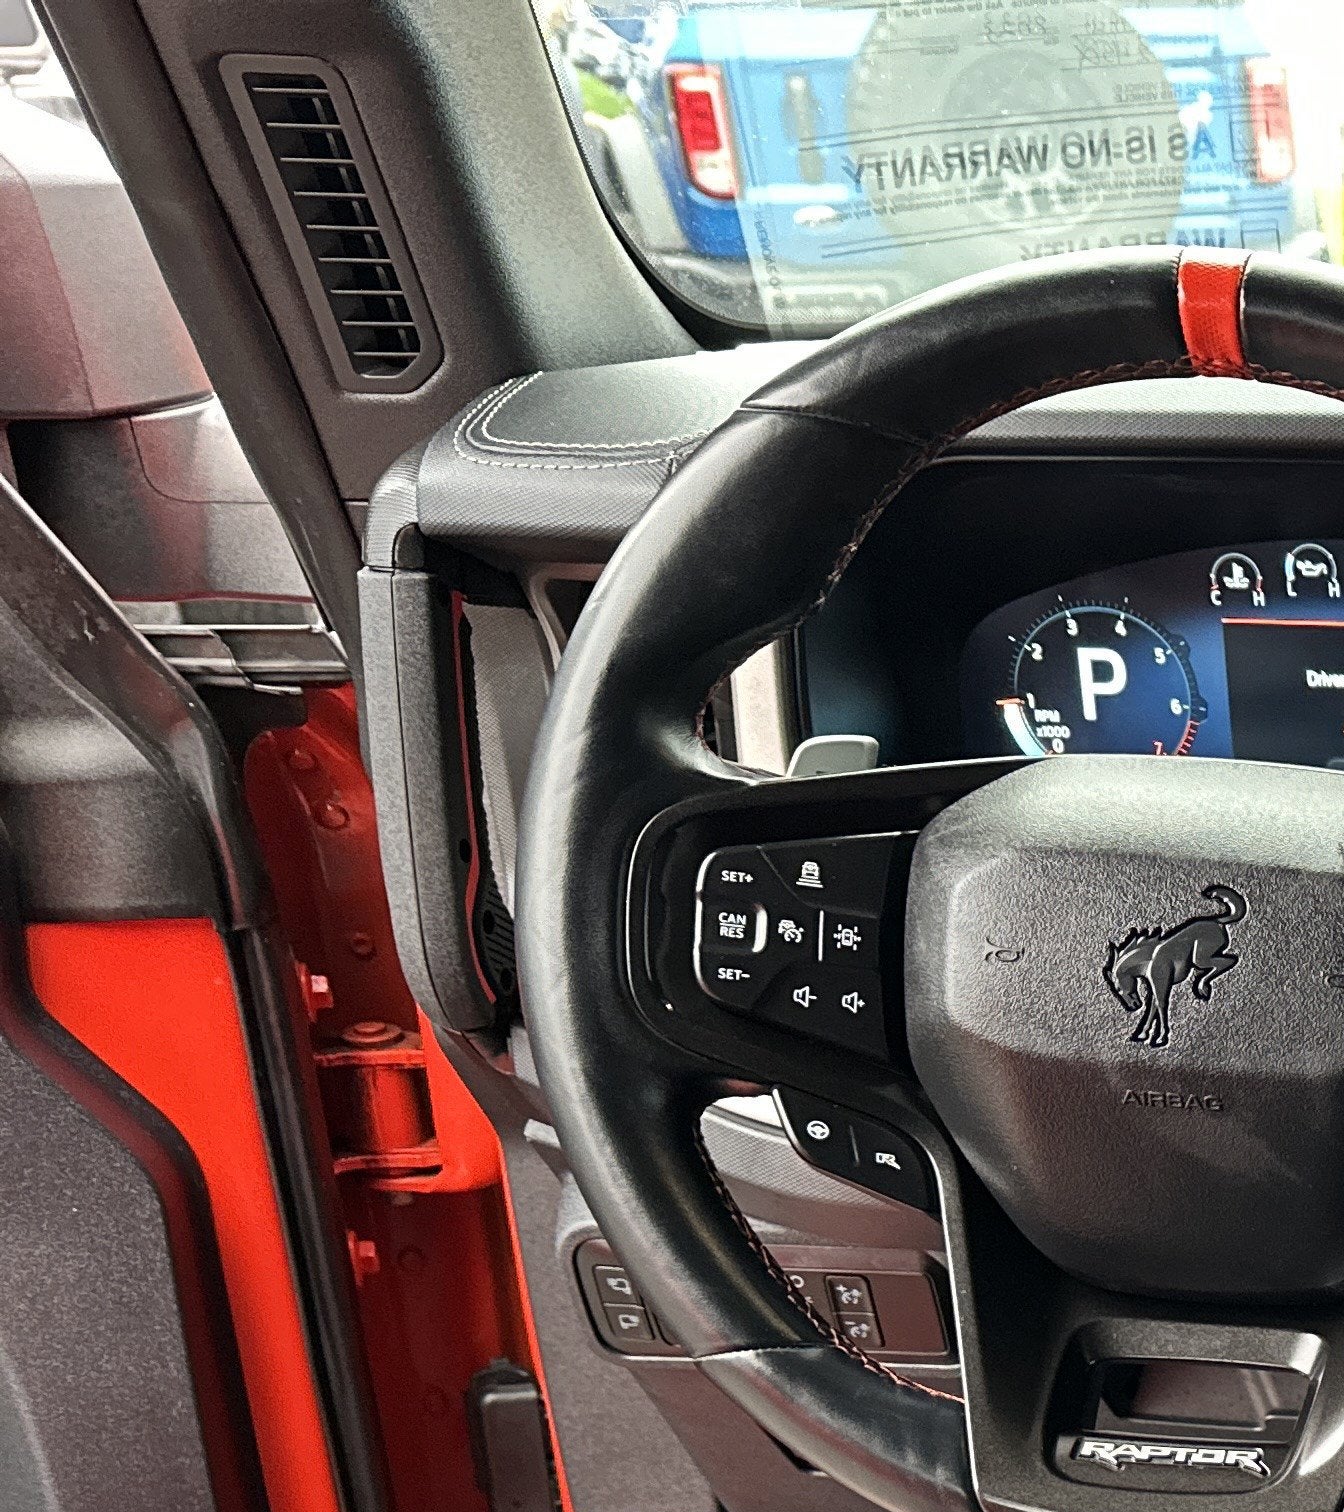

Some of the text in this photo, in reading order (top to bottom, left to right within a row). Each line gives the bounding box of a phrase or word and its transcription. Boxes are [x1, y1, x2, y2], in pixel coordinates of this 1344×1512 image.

[1287, 580, 1297, 597] L
[1328, 580, 1341, 598] H
[1210, 590, 1222, 606] C
[1252, 591, 1265, 606] H
[1066, 618, 1078, 636] 3
[1115, 620, 1127, 637] 4
[1031, 642, 1043, 660] 2
[1154, 647, 1166, 664] 5
[1076, 647, 1127, 721] P
[1170, 698, 1182, 715] 6
[1034, 709, 1060, 722] RPM
[1052, 738, 1064, 753] 0
[720, 870, 754, 883] SET+
[718, 912, 747, 924] CAN
[719, 926, 744, 939] RES
[1121, 1088, 1224, 1112] AIRBAG
[1079, 1440, 1270, 1477] RAPTOR
